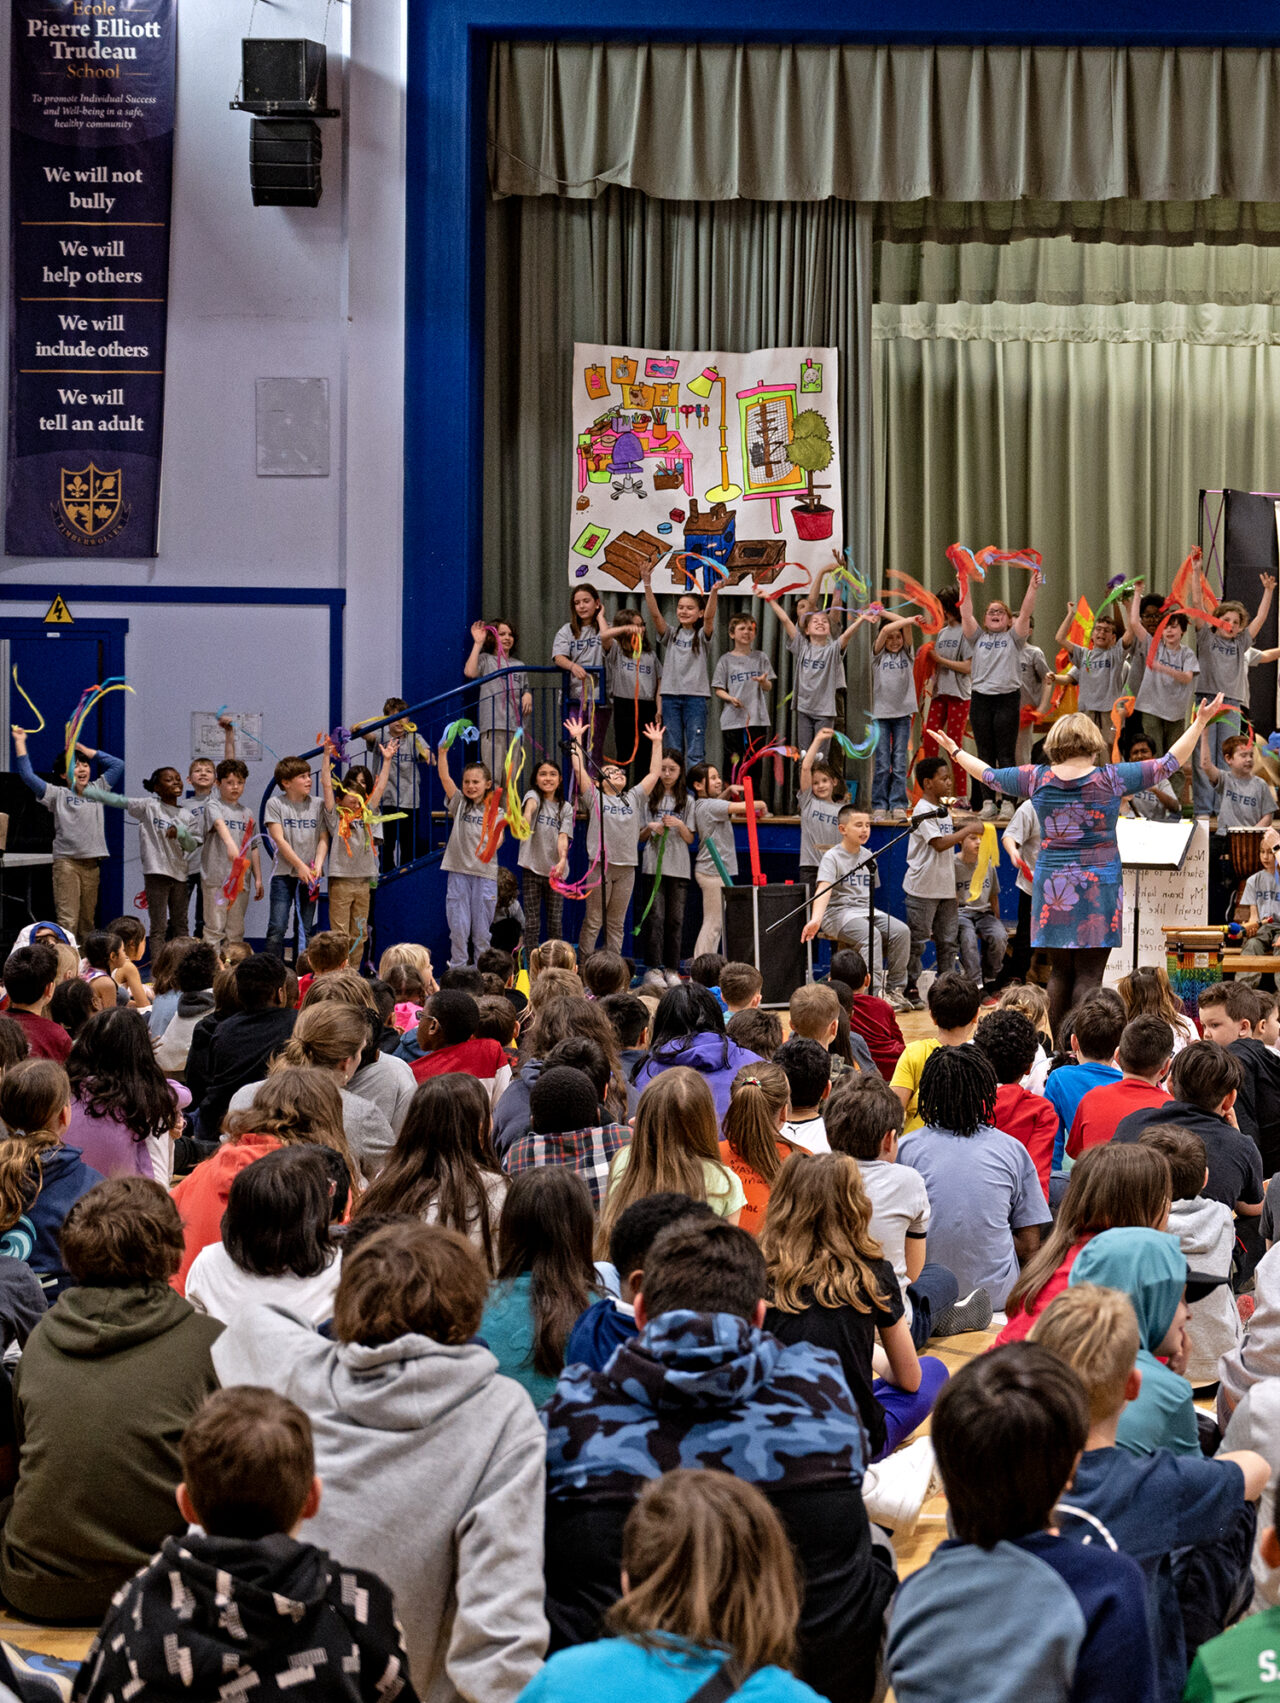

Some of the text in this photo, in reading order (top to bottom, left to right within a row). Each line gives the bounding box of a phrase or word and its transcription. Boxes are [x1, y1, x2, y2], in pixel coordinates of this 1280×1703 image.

[27, 18, 161, 38] Pierre Elliott
[50, 41, 137, 59] Trudeau
[66, 63, 120, 79] School
[32, 93, 157, 105] To promote Individual Success
[43, 106, 60, 115] and
[63, 106, 105, 118] Well-being
[107, 107, 115, 115] in
[55, 119, 133, 130] healthy community
[43, 166, 143, 183] We will not
[69, 192, 116, 213] bully
[59, 240, 125, 257] We will
[42, 266, 142, 287] help others
[58, 315, 125, 331] We will
[35, 340, 149, 357] include others
[57, 389, 124, 405] We will
[39, 414, 144, 431] tell an adult
[1225, 790, 1257, 807] PETES
[283, 819, 317, 829] PETES
[811, 810, 839, 825] PETE
[840, 874, 870, 887] PETE
